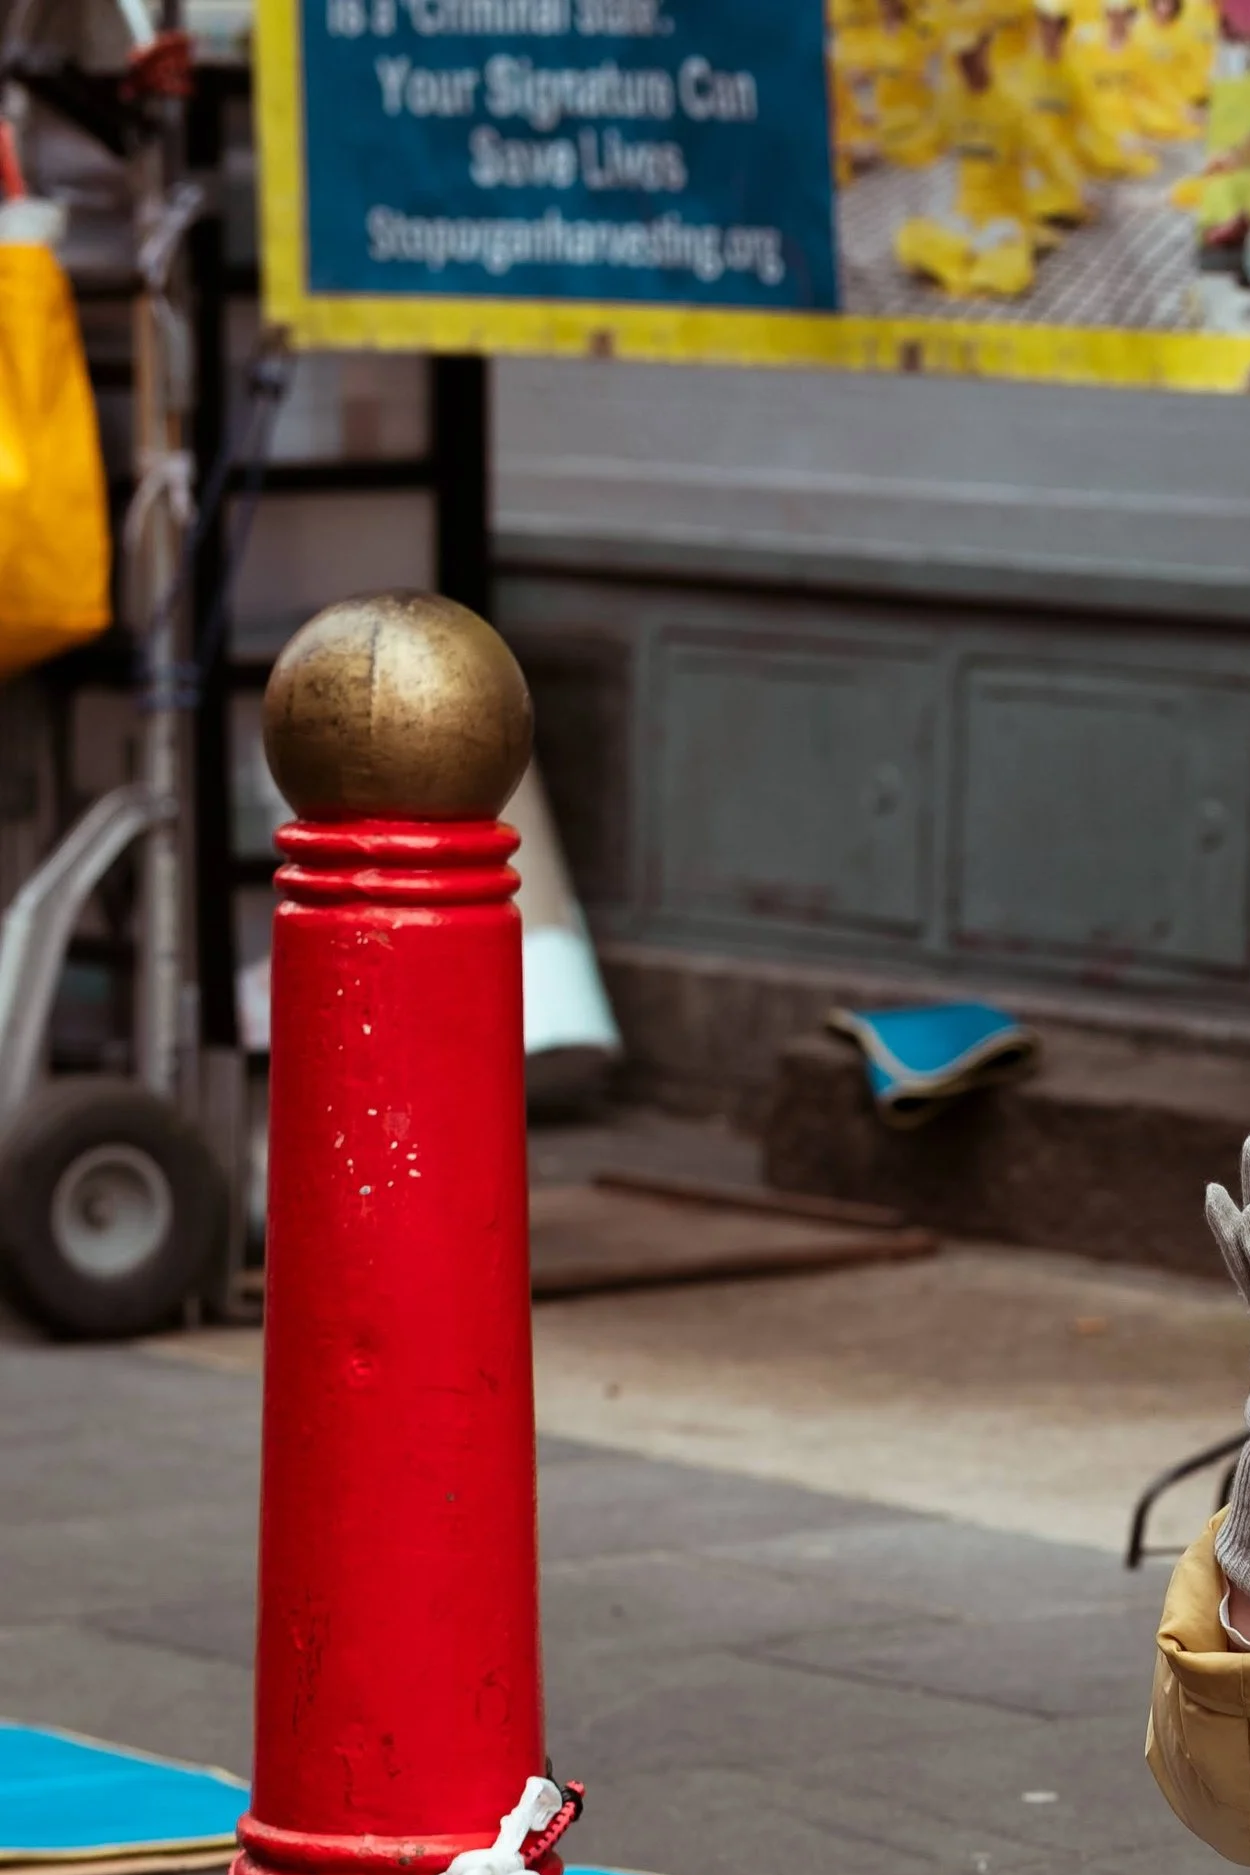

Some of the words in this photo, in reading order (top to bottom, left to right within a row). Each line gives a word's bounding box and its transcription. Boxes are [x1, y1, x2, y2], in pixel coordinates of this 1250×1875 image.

[375, 54, 479, 118] Your
[469, 124, 577, 190] Save
[579, 127, 689, 192] Lives
[365, 203, 786, 286] Stoporganharvesting.org
